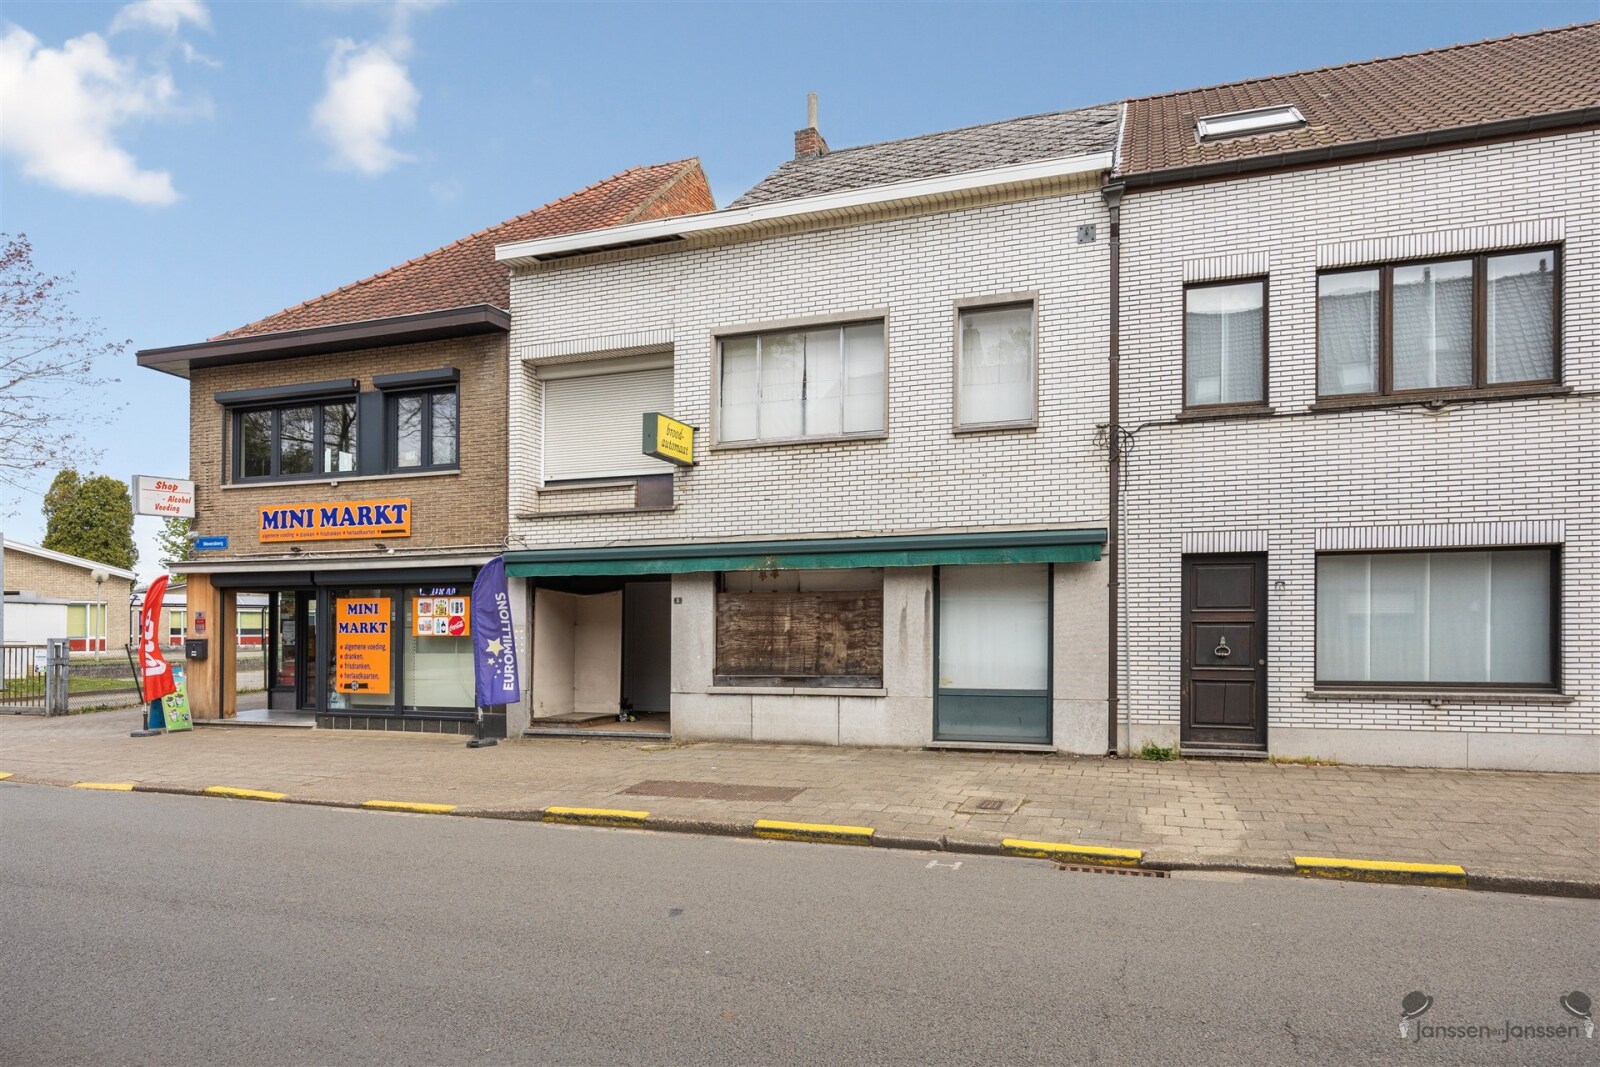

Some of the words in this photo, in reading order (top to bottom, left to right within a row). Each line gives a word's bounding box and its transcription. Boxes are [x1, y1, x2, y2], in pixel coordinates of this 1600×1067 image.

[155, 481, 179, 492] Shop
[167, 495, 192, 504] Alcohol
[154, 503, 181, 514] Voeding
[261, 508, 315, 530] MINI
[319, 504, 408, 528] MARKT
[347, 603, 379, 615] MINI
[338, 622, 388, 634] MARKT
[494, 591, 515, 691] EUROMILLIONS
[344, 643, 366, 651] algemene
